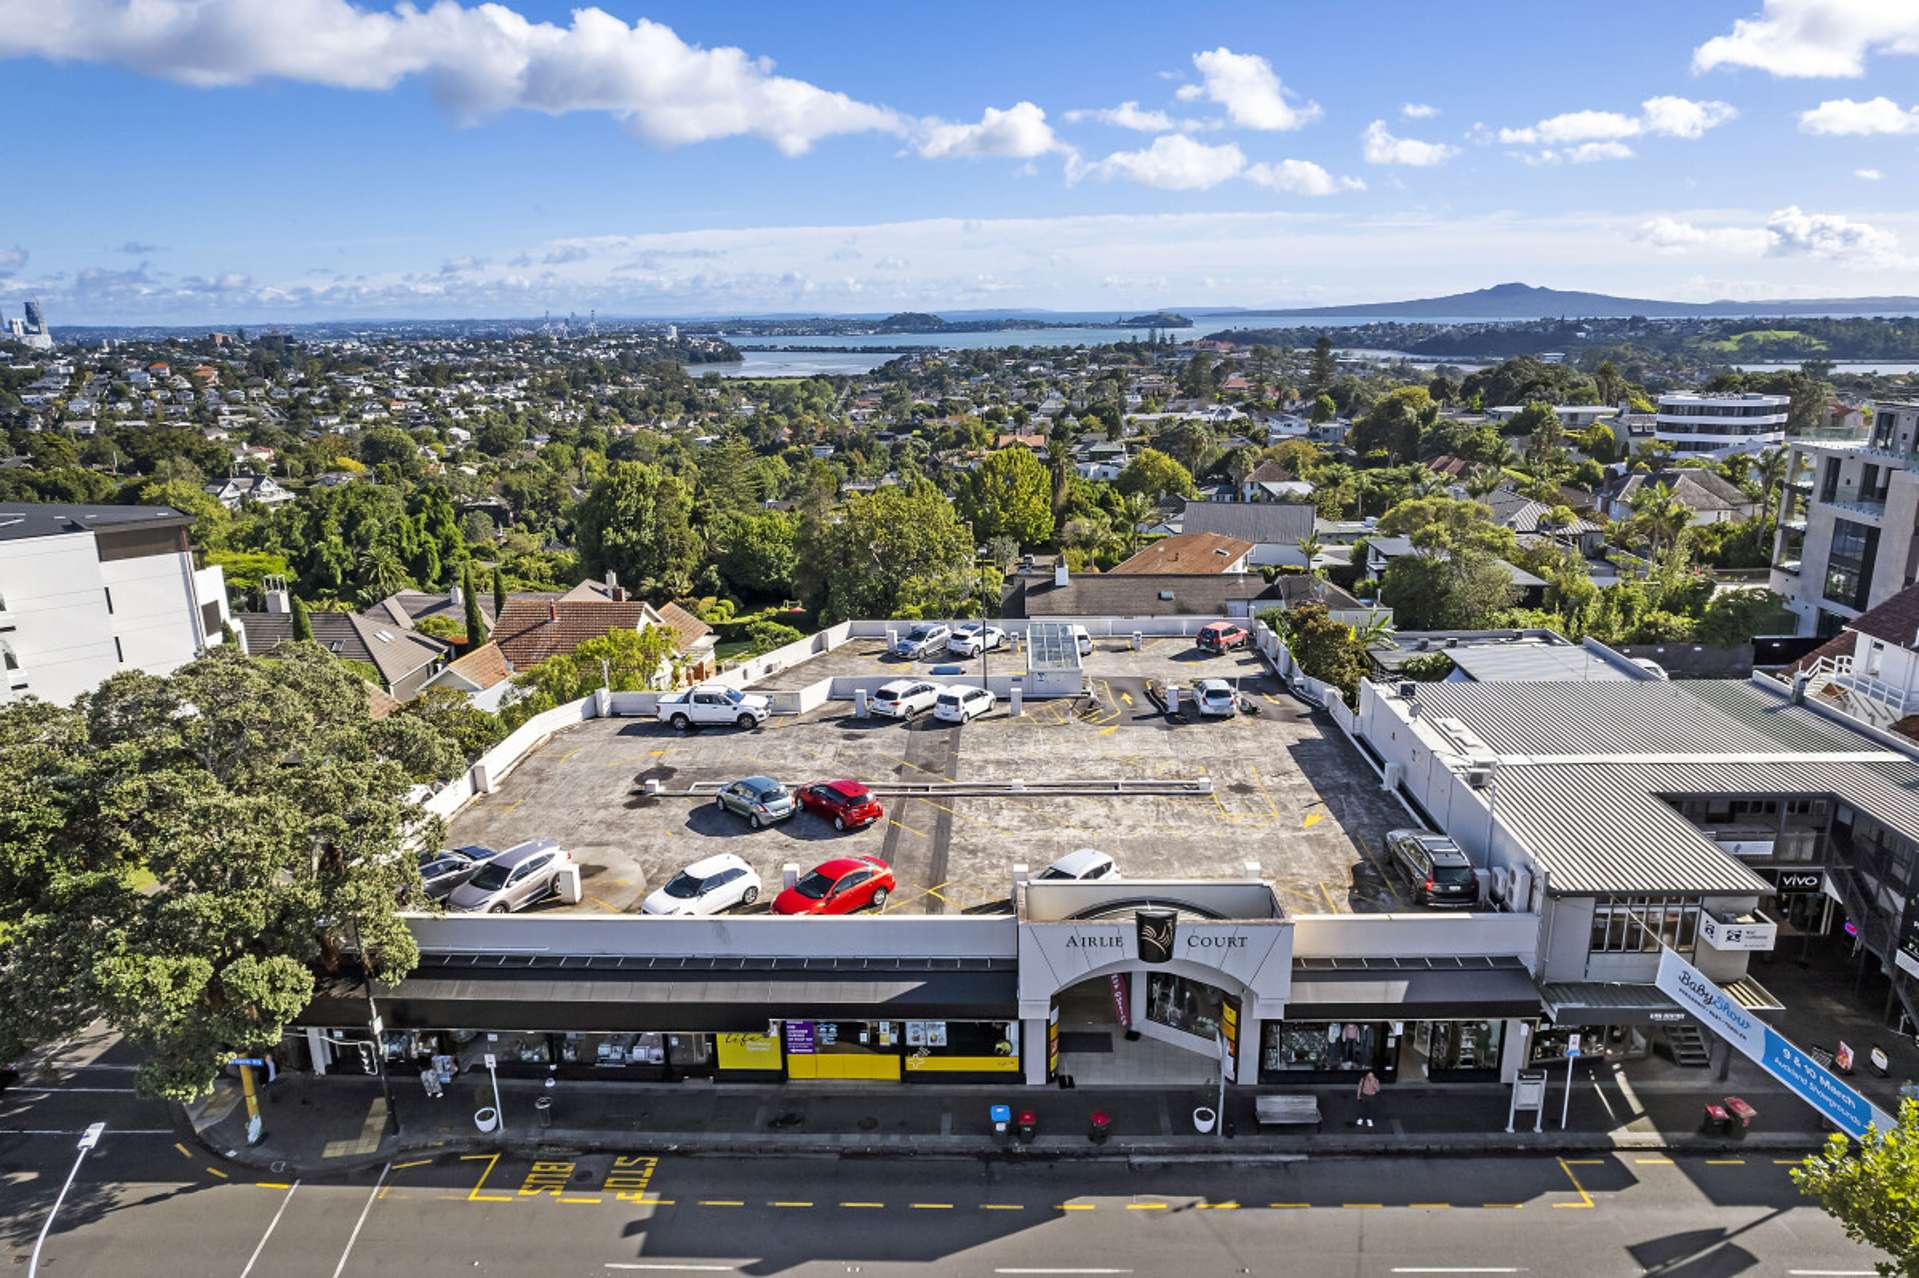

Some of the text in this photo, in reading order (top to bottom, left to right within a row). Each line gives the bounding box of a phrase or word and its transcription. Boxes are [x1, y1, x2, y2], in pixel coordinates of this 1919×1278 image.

[1066, 935, 1249, 948] AIRLIE COURT
[518, 1161, 577, 1196] BUS
[602, 1156, 659, 1200] STOP
